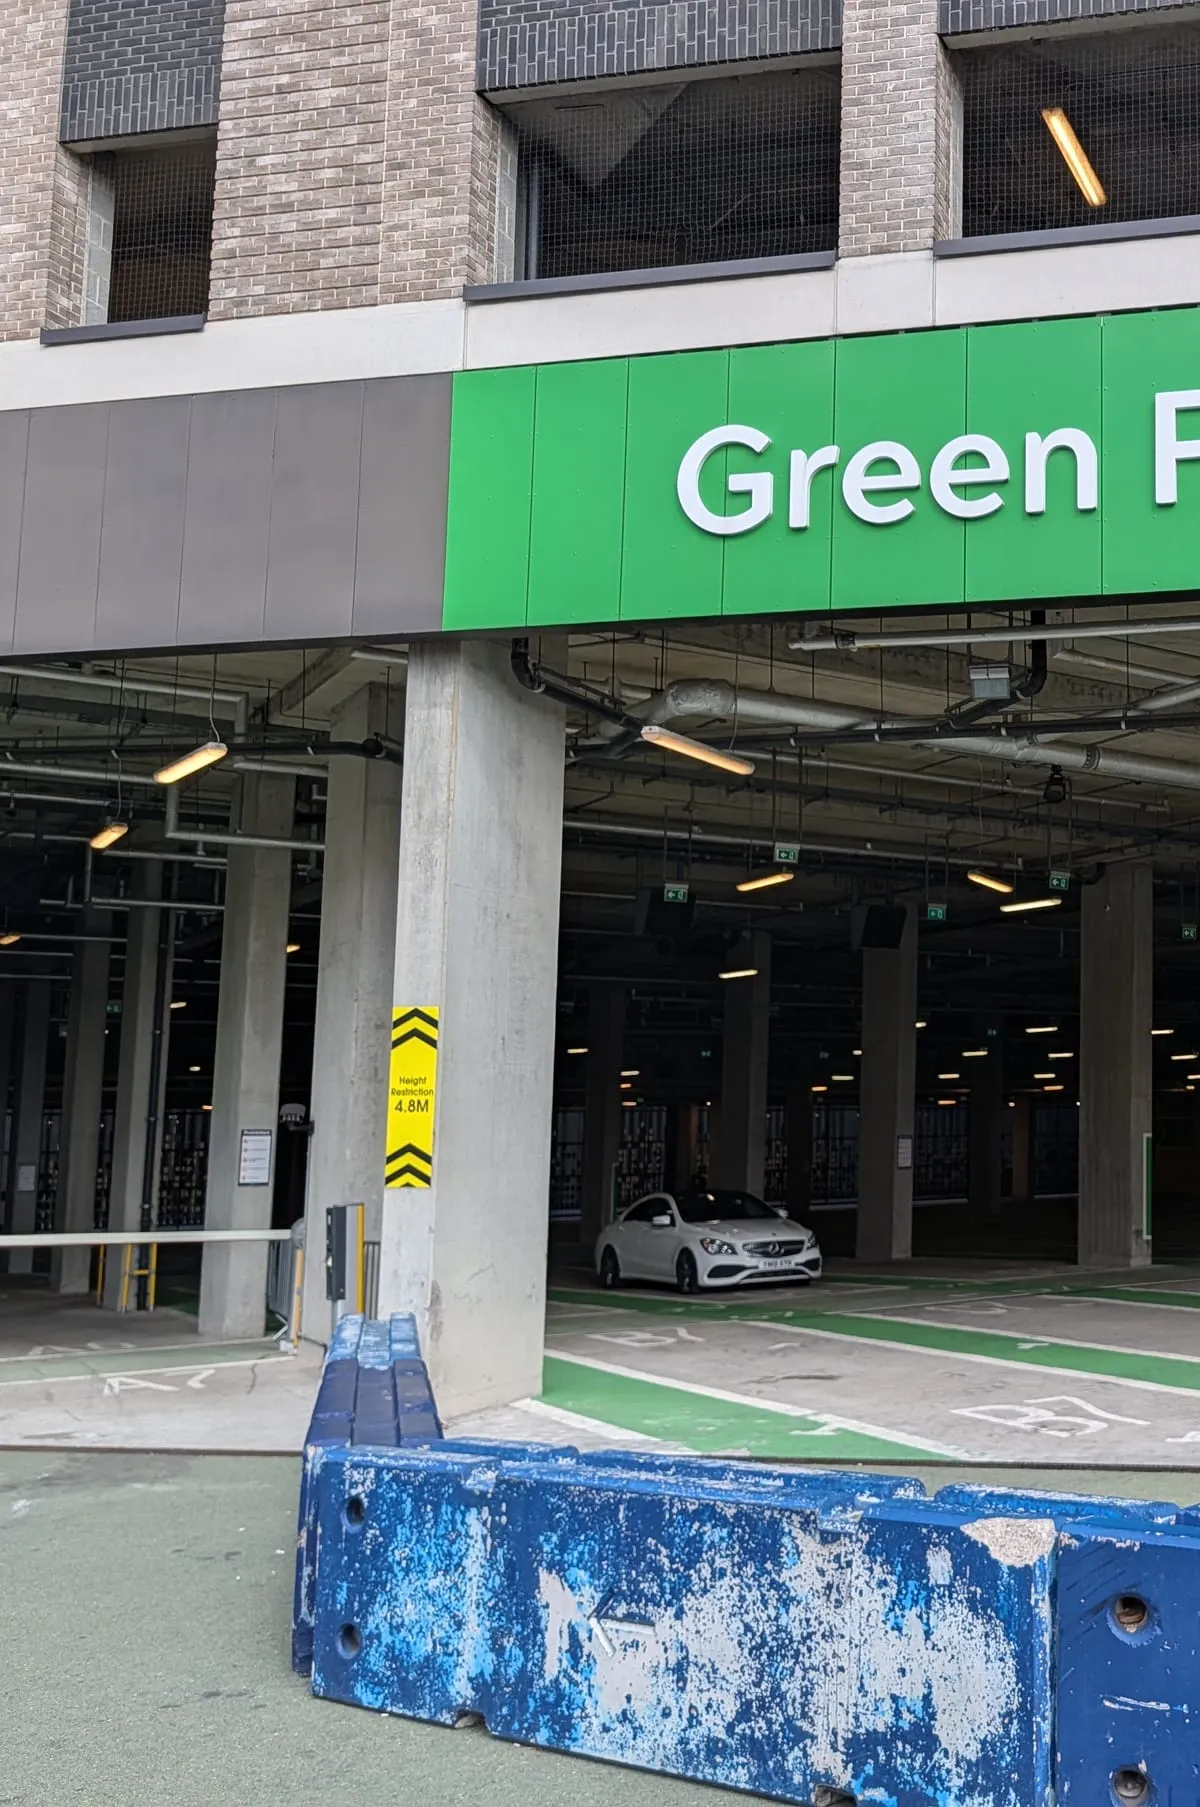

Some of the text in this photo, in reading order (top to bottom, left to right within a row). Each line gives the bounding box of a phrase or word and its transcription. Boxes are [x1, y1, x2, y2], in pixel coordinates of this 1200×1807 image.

[676, 423, 1098, 534] Green
[399, 1076, 427, 1086] Height
[391, 1088, 434, 1096] Restriction
[394, 1099, 429, 1113] 4.8M
